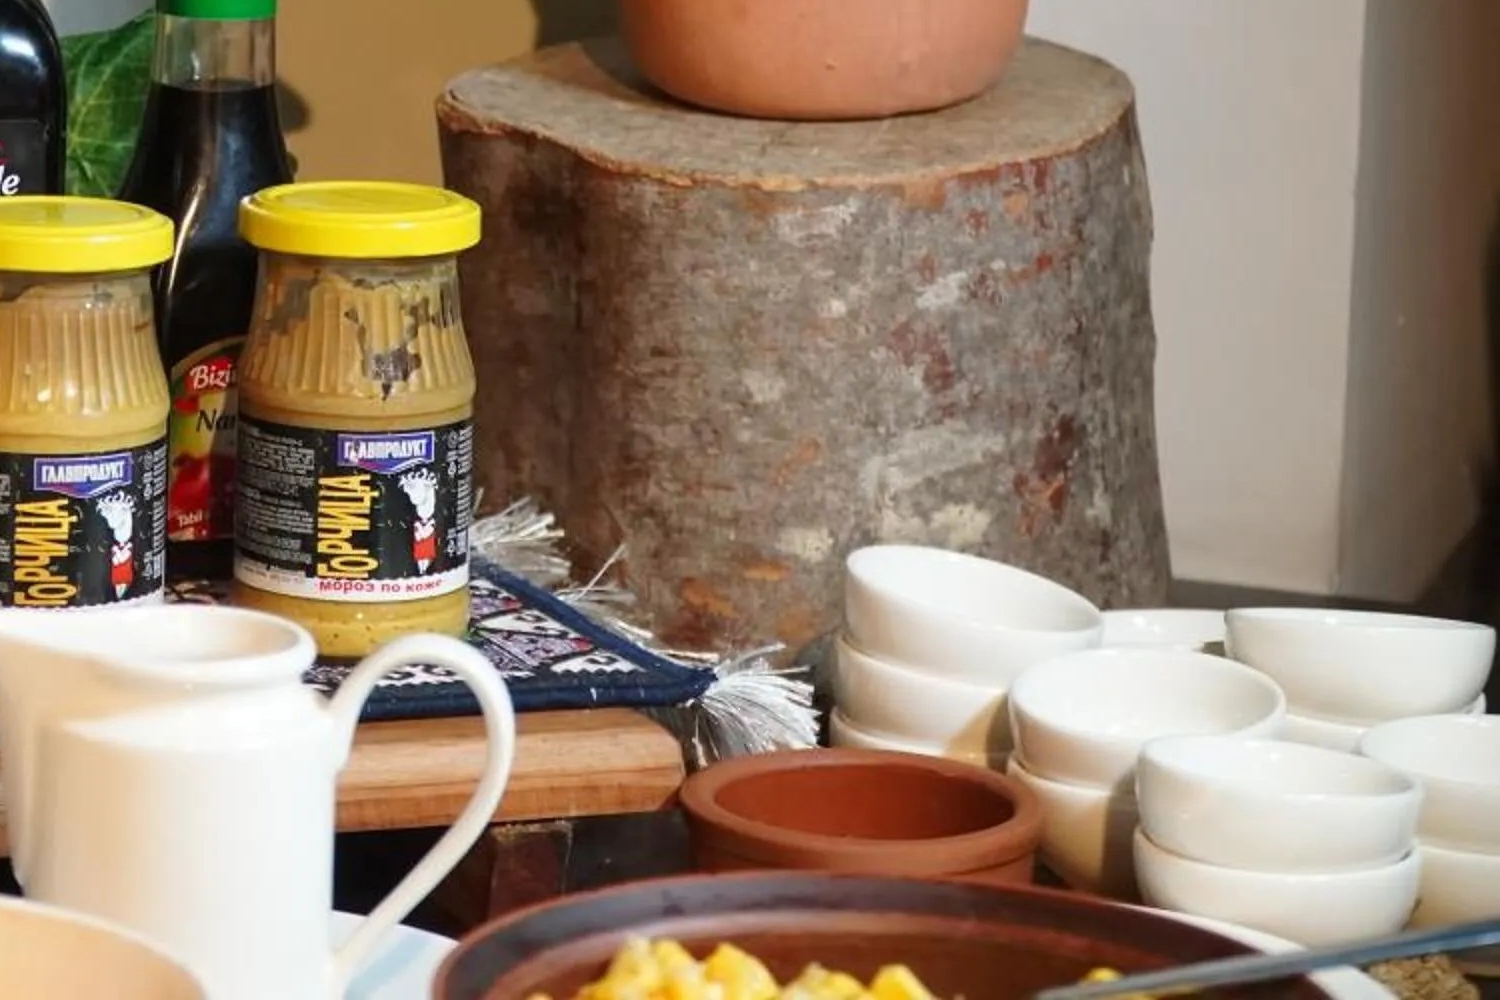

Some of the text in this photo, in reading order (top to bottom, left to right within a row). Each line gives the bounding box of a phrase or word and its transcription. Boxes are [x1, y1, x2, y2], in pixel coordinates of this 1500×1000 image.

[190, 363, 236, 389] Bizi
[14, 499, 78, 605] ГОРЧИЦА
[316, 474, 379, 578] ГОРЧИЦА
